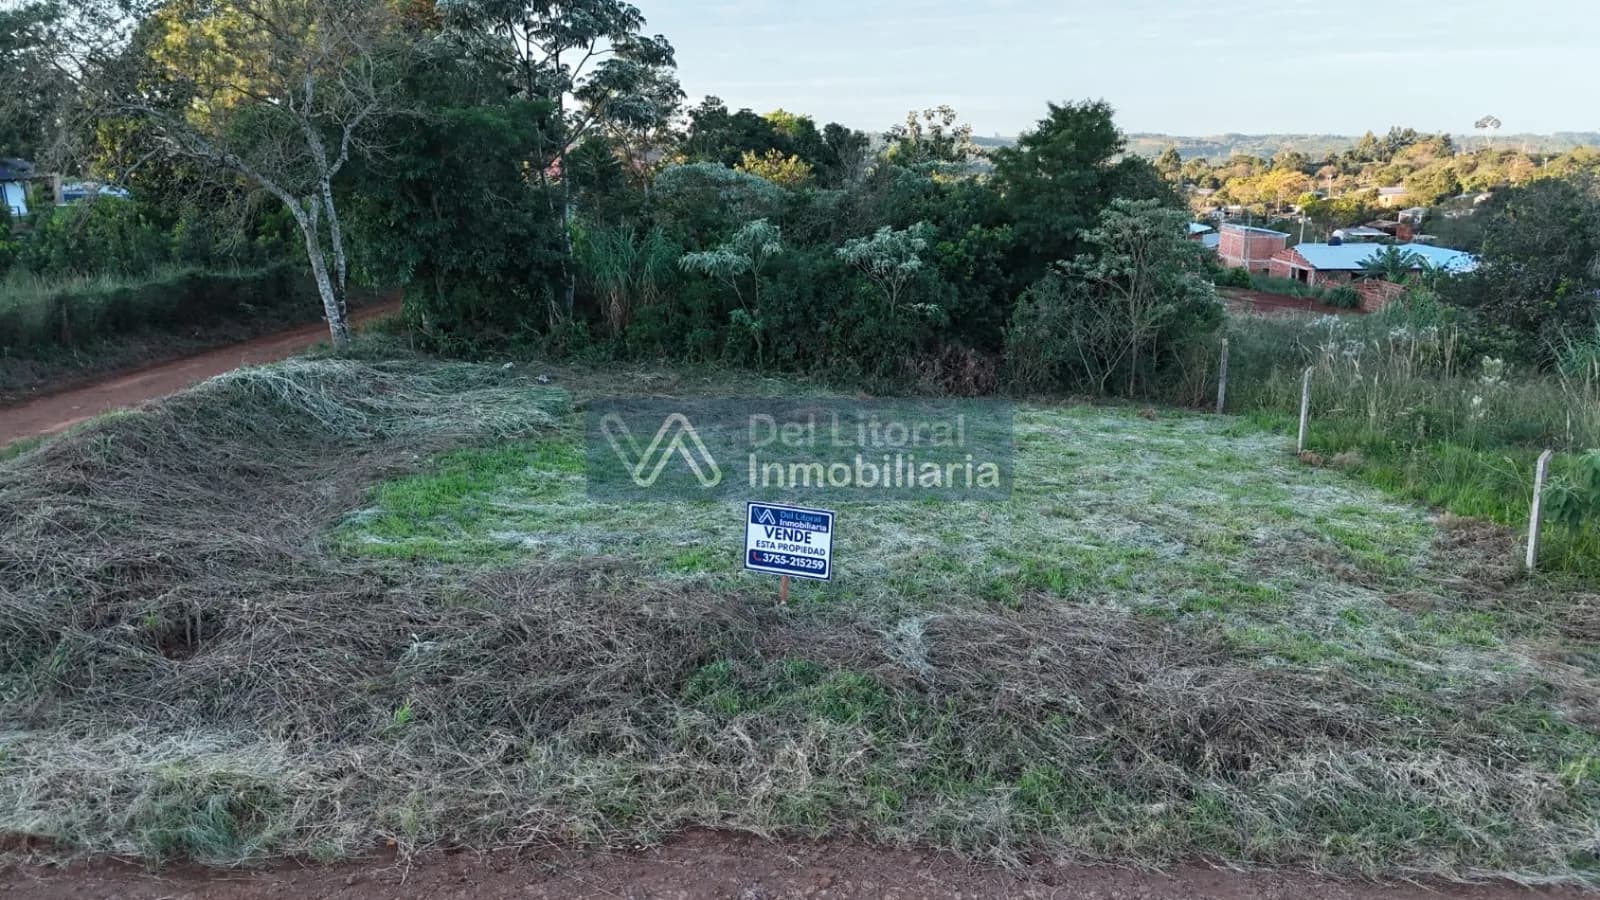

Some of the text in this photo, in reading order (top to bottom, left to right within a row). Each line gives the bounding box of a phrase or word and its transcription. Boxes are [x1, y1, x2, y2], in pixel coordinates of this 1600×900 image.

[779, 519, 826, 531] Inmobiliaria
[764, 526, 812, 544] VENDE
[756, 540, 825, 555] ESTA PROPIEDAD
[762, 553, 825, 569] 3755-215259
